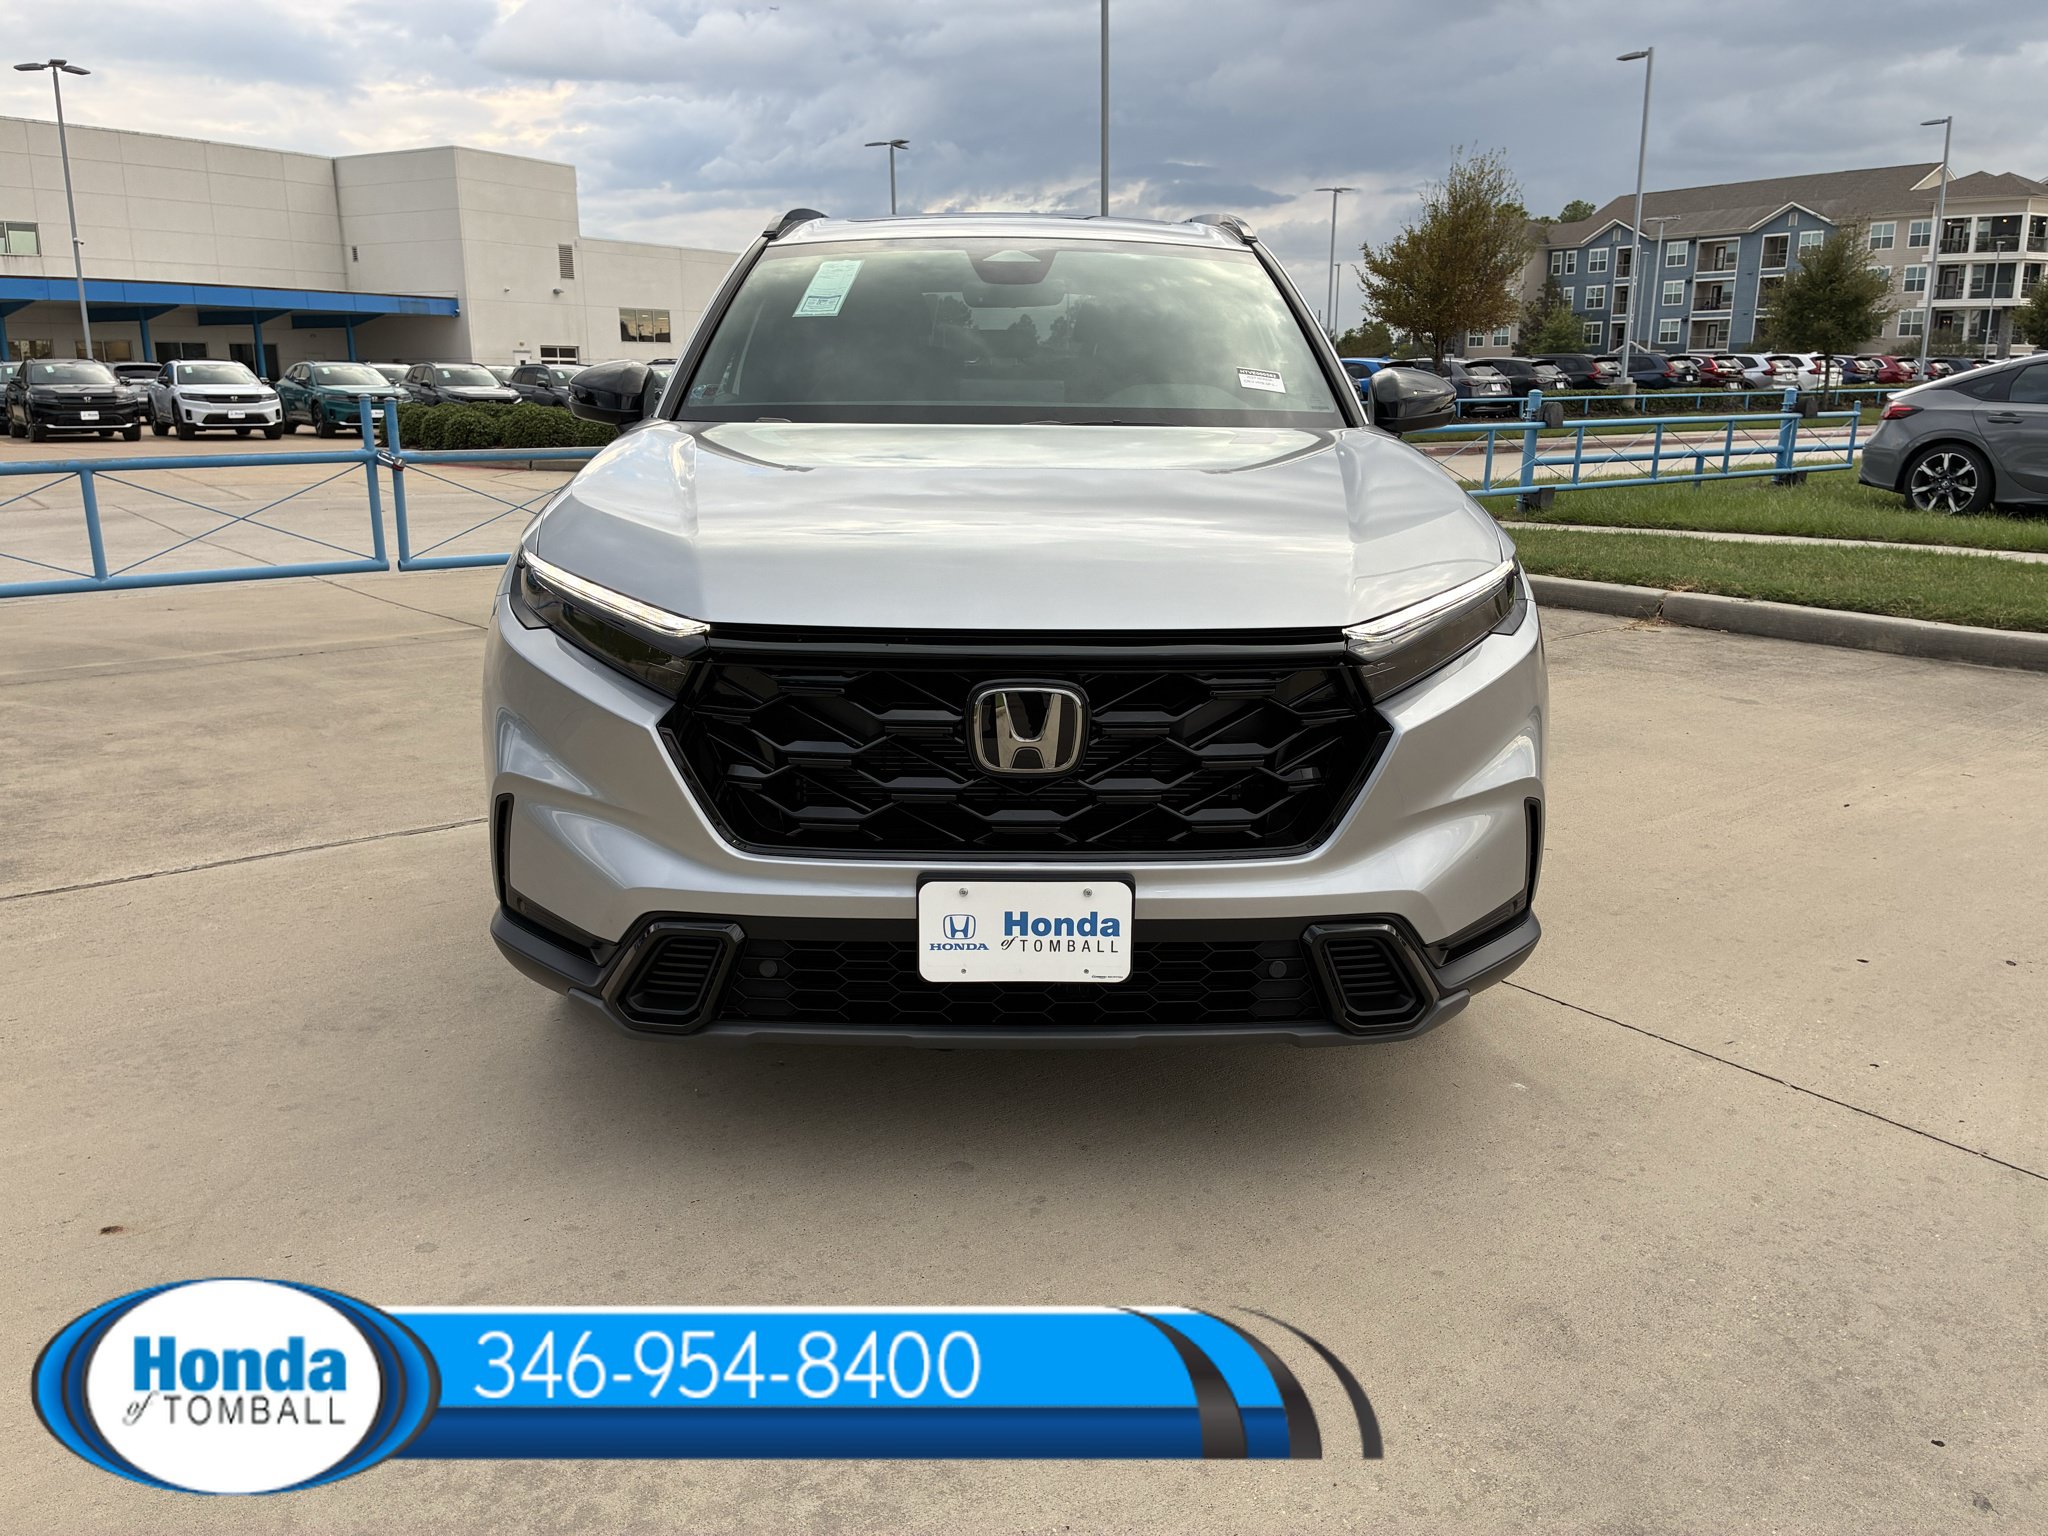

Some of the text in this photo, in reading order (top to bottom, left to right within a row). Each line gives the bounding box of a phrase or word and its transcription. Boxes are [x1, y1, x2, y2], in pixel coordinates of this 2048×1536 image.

[1004, 911, 1121, 937] Honda
[929, 943, 990, 951] HONDA
[1001, 936, 1119, 953] of TOMBALL
